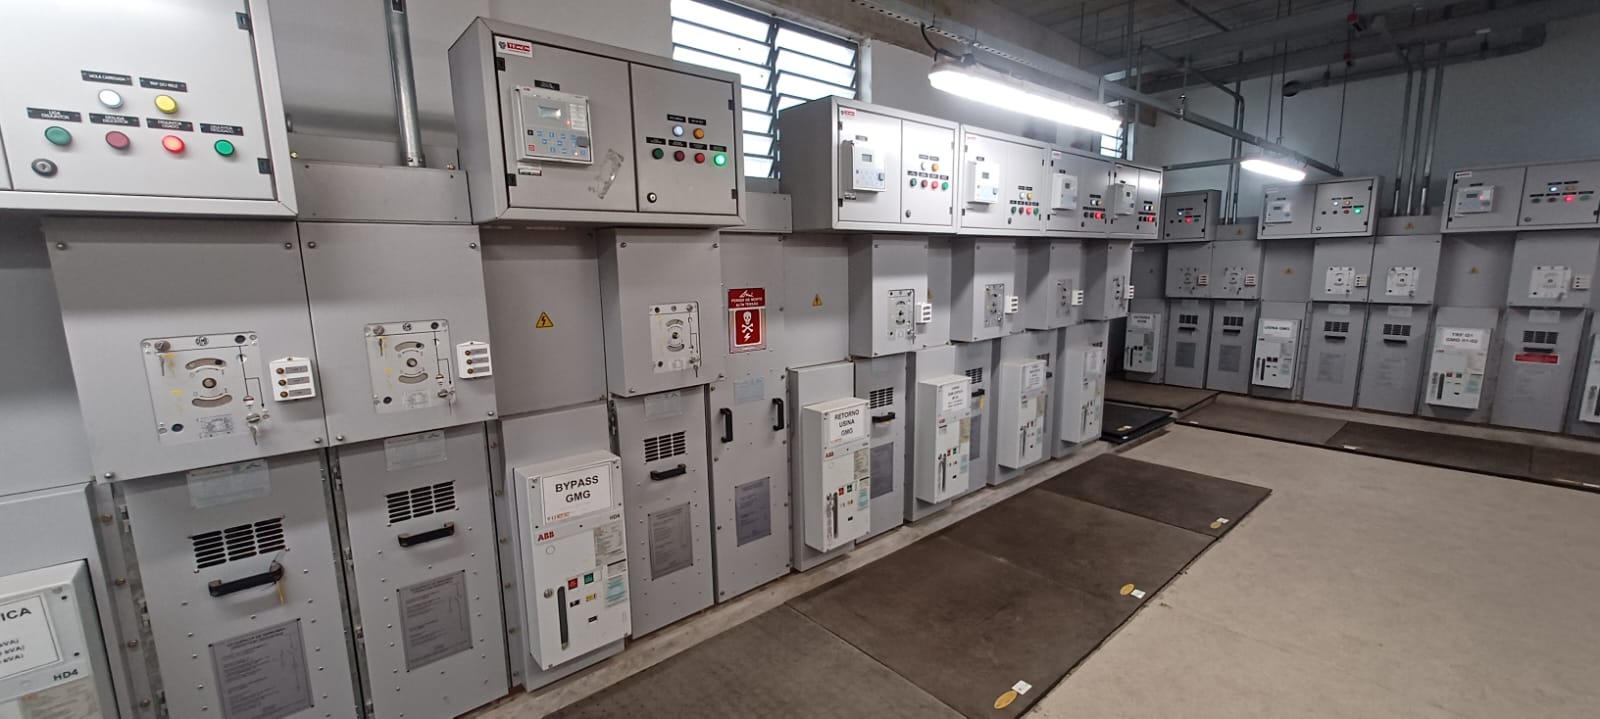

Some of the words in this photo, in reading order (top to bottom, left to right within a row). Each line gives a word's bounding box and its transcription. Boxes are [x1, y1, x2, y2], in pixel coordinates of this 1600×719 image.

[834, 409, 859, 420] RETORNO
[839, 418, 855, 428] USINA
[841, 427, 853, 436] GMG
[555, 475, 599, 493] BYPASS
[565, 490, 591, 503] GMG
[537, 531, 555, 541] ABB
[53, 668, 79, 681] HD4
